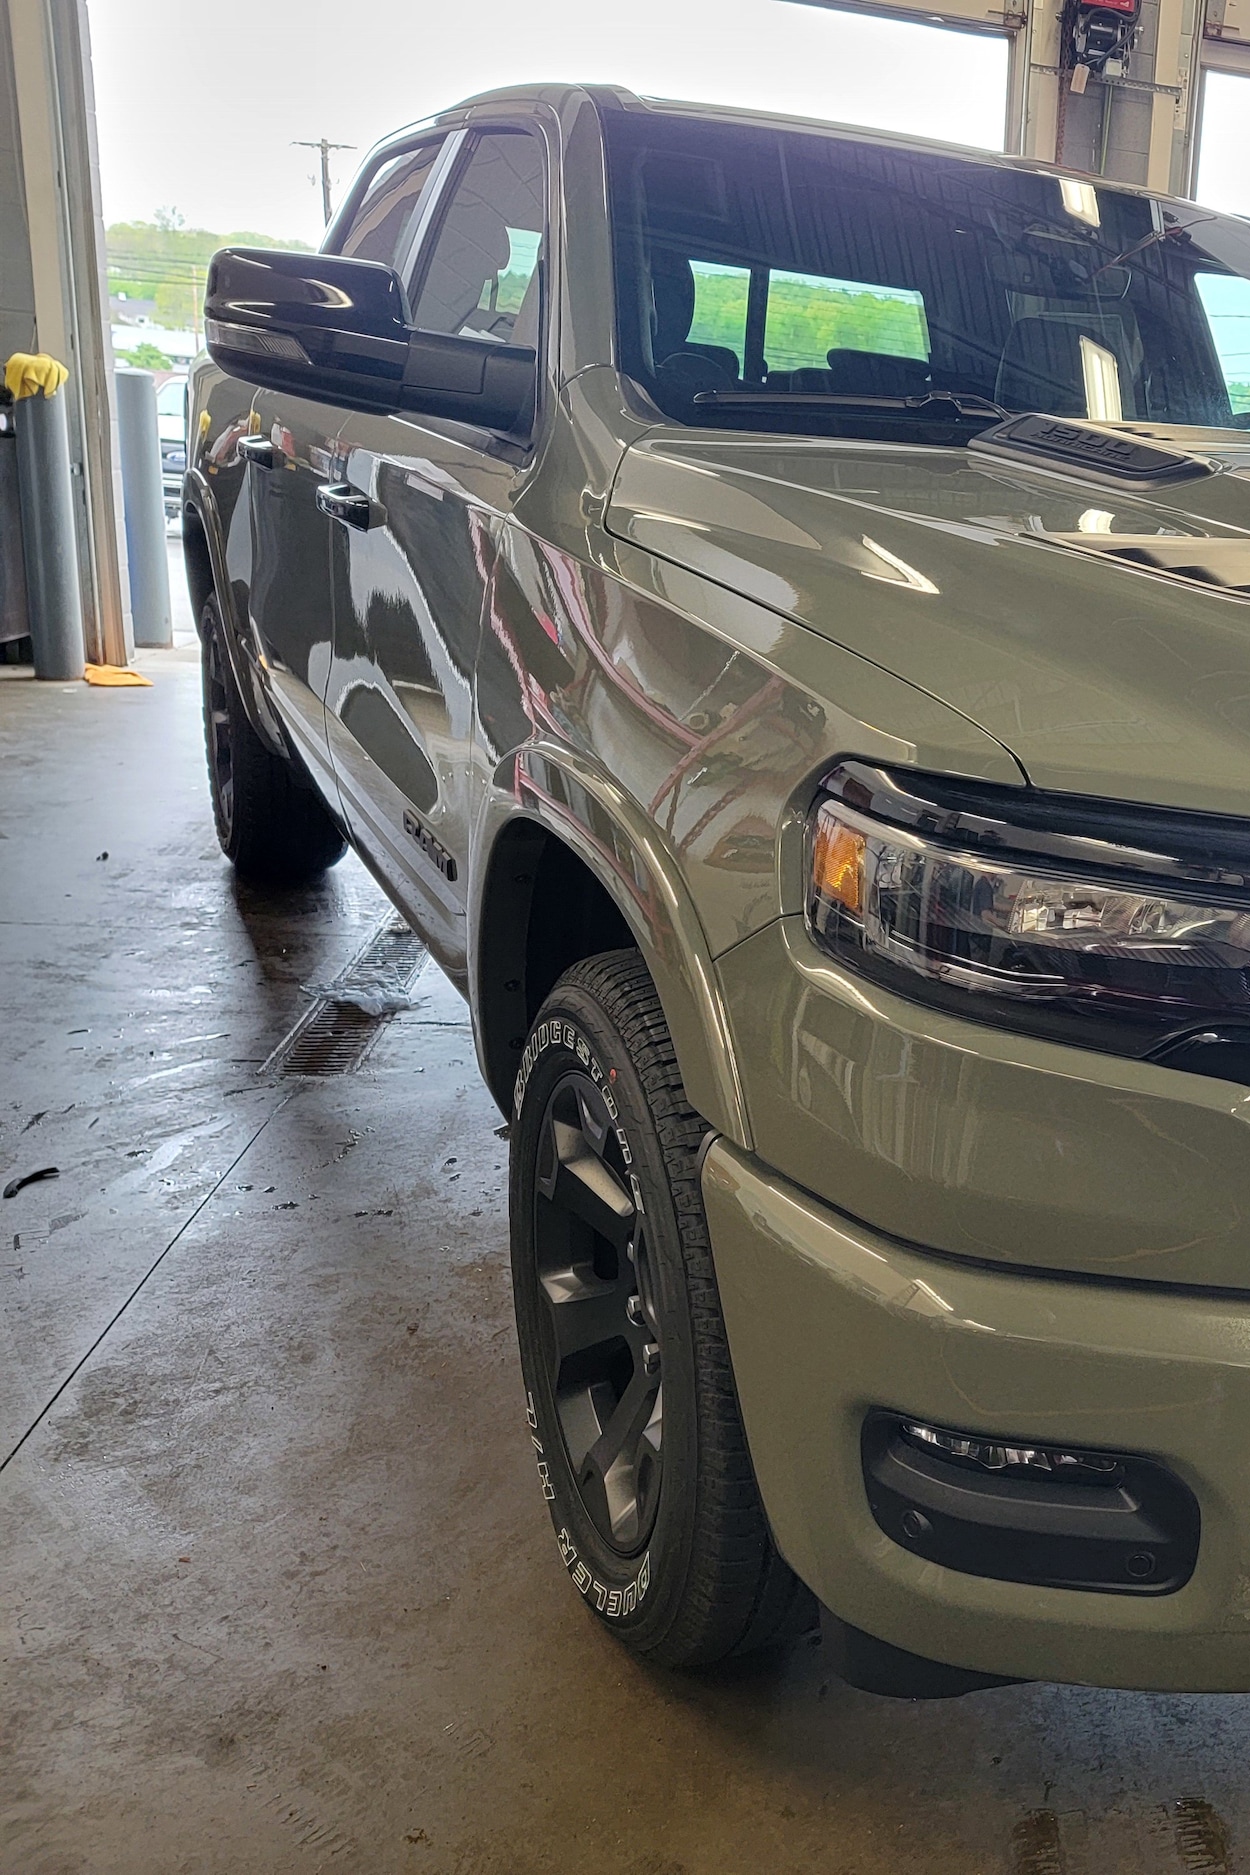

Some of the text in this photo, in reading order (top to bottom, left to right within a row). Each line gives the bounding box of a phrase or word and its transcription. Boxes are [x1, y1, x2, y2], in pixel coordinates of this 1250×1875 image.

[1039, 422, 1138, 456] 1500
[402, 808, 458, 882] RAM
[556, 1527, 651, 1618] DUELER
